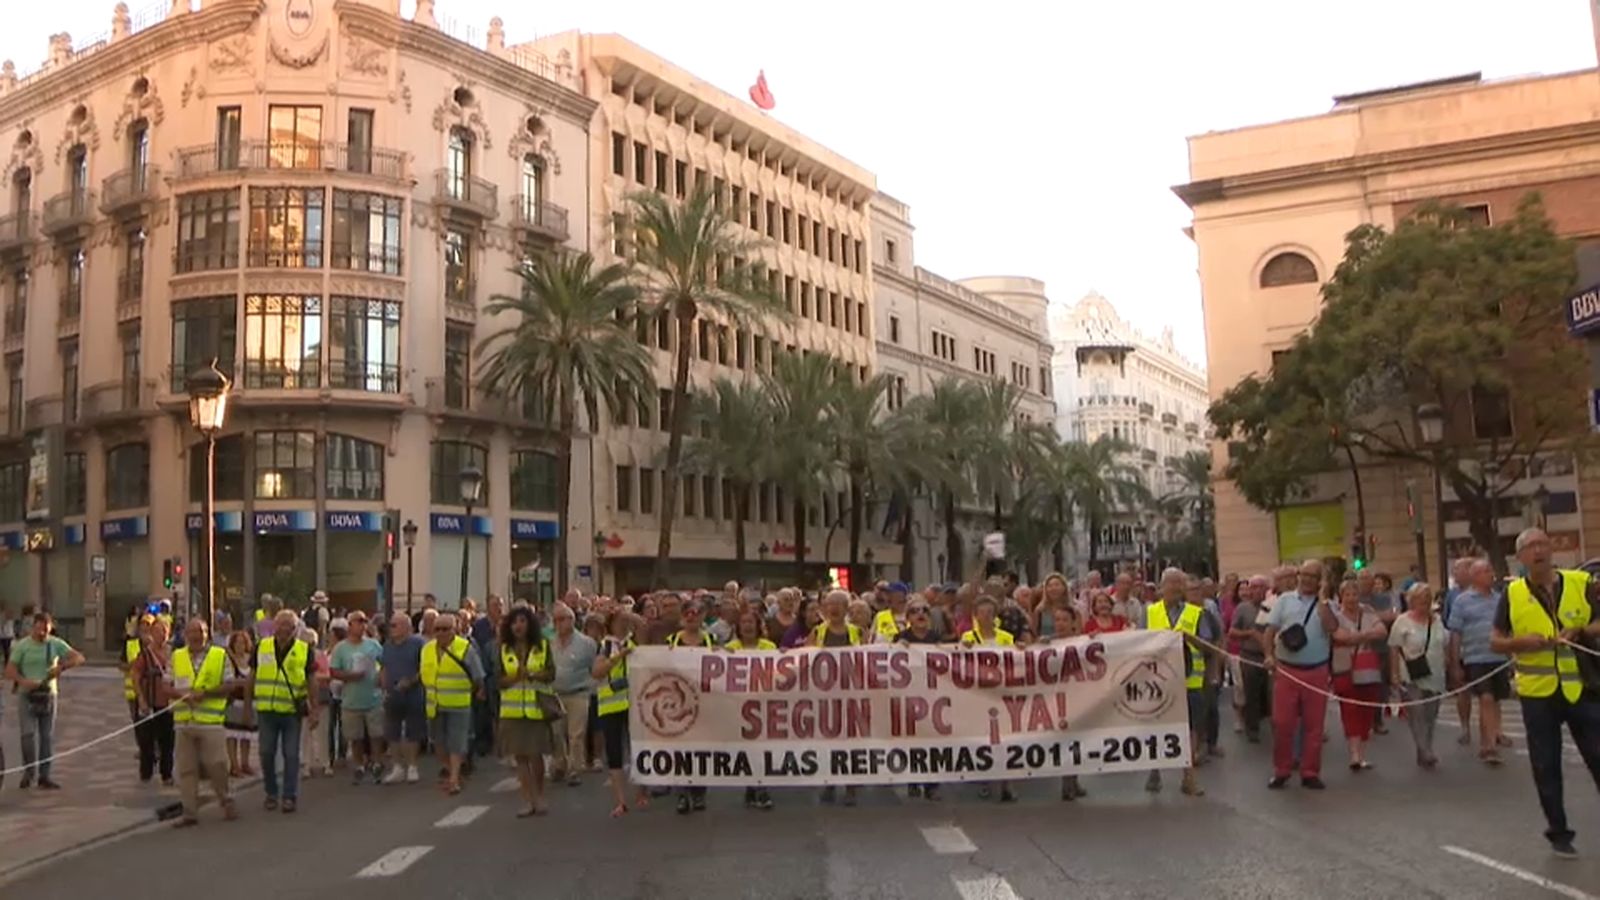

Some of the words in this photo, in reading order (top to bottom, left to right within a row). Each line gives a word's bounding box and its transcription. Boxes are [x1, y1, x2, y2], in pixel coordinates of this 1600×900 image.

[255, 513, 289, 527] BBVA
[330, 514, 362, 527] BBVA
[437, 516, 460, 530] BBVA
[517, 522, 537, 534] BBVA
[700, 651, 912, 693] PENSIONES
[926, 642, 1108, 690] PUBLICAS
[741, 698, 872, 740] SEGUN
[890, 697, 952, 737] IPC
[988, 692, 1068, 745] ¡YA!
[636, 750, 752, 777] CONTRA
[764, 750, 818, 776] LAS
[831, 746, 993, 776] REFORMAS
[1006, 734, 1182, 770] 2011-2013
